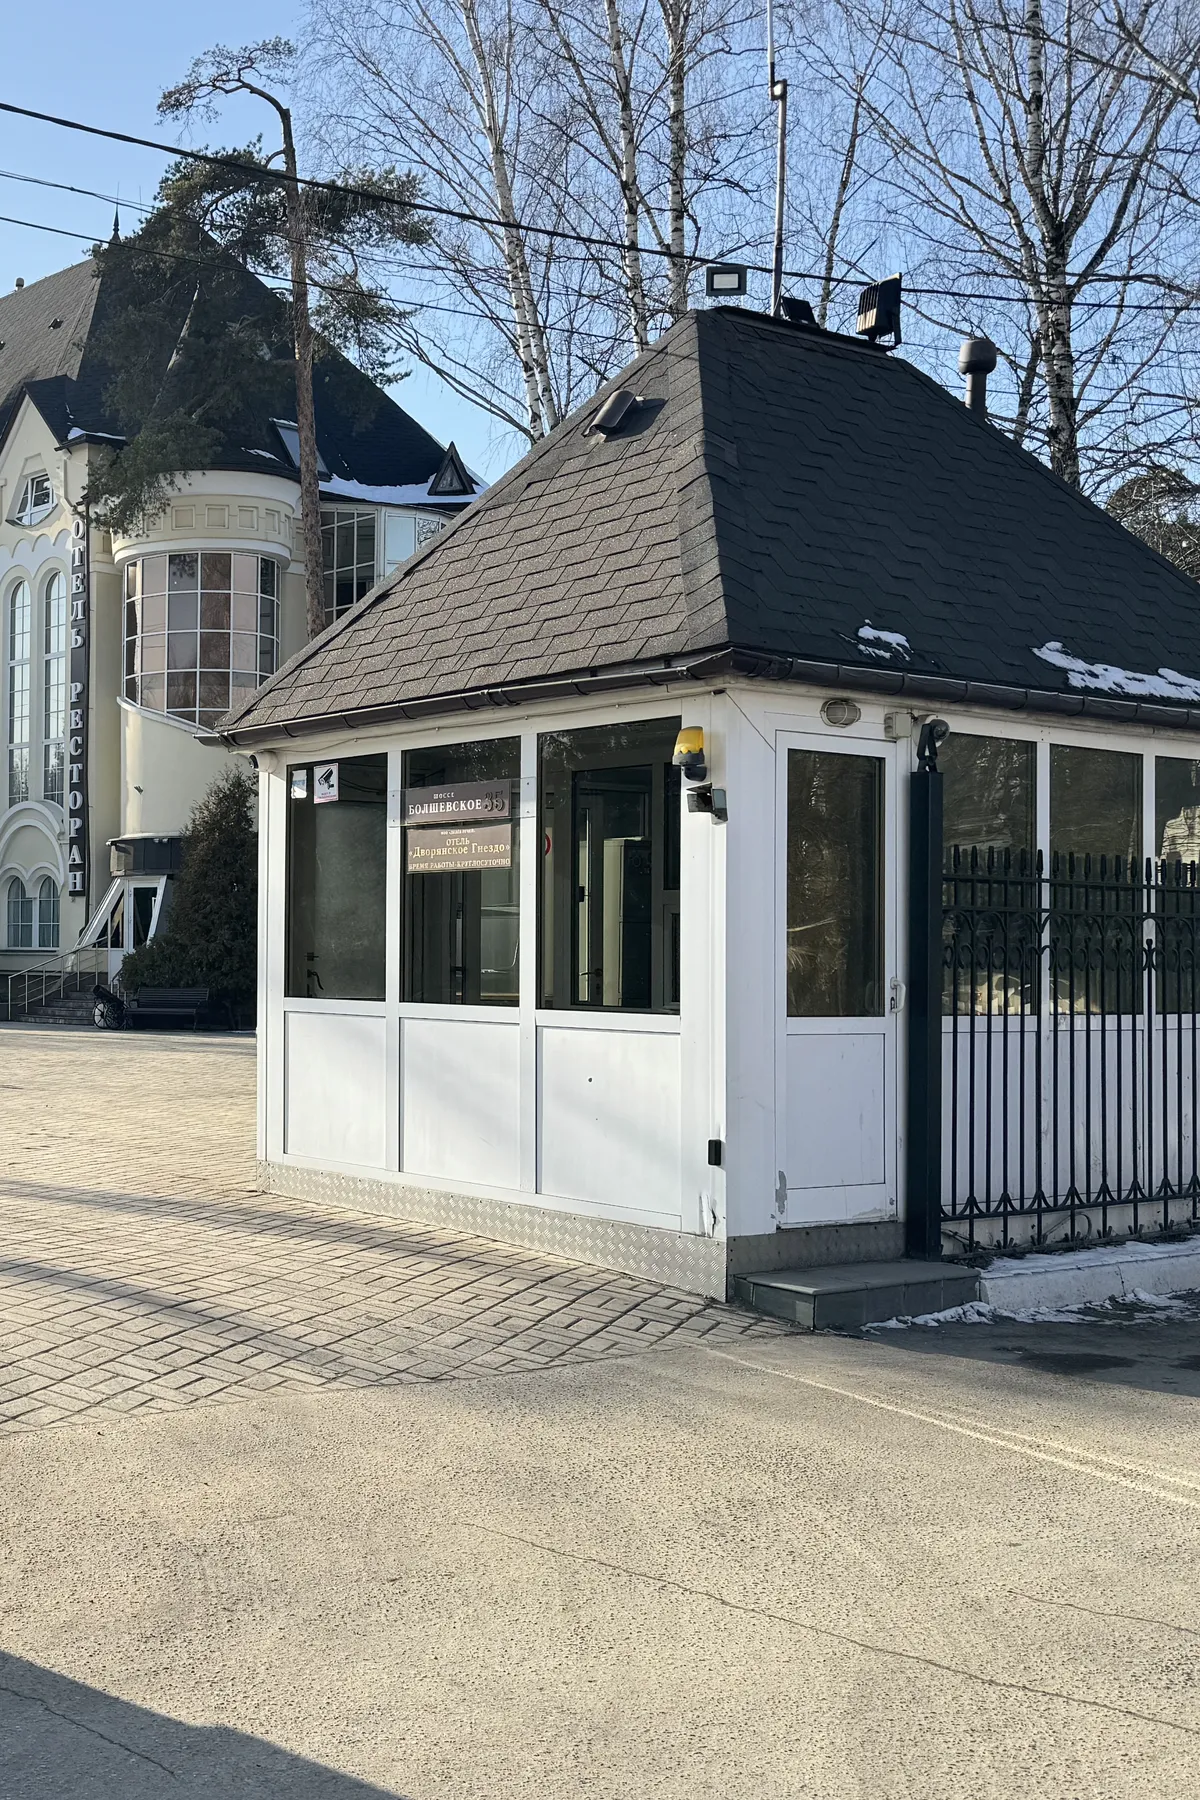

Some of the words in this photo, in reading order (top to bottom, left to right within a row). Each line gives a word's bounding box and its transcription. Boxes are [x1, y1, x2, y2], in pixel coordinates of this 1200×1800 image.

[71, 519, 85, 649] ОТЕЛЬ
[68, 682, 84, 892] РЕСТОРАН
[408, 799, 482, 816] БОЛШЕВСКОЕ
[484, 790, 506, 812] 35
[408, 846, 469, 859] «Дворянское
[471, 843, 510, 854] Гнездо»
[446, 838, 470, 847] ОТЕЛЬ
